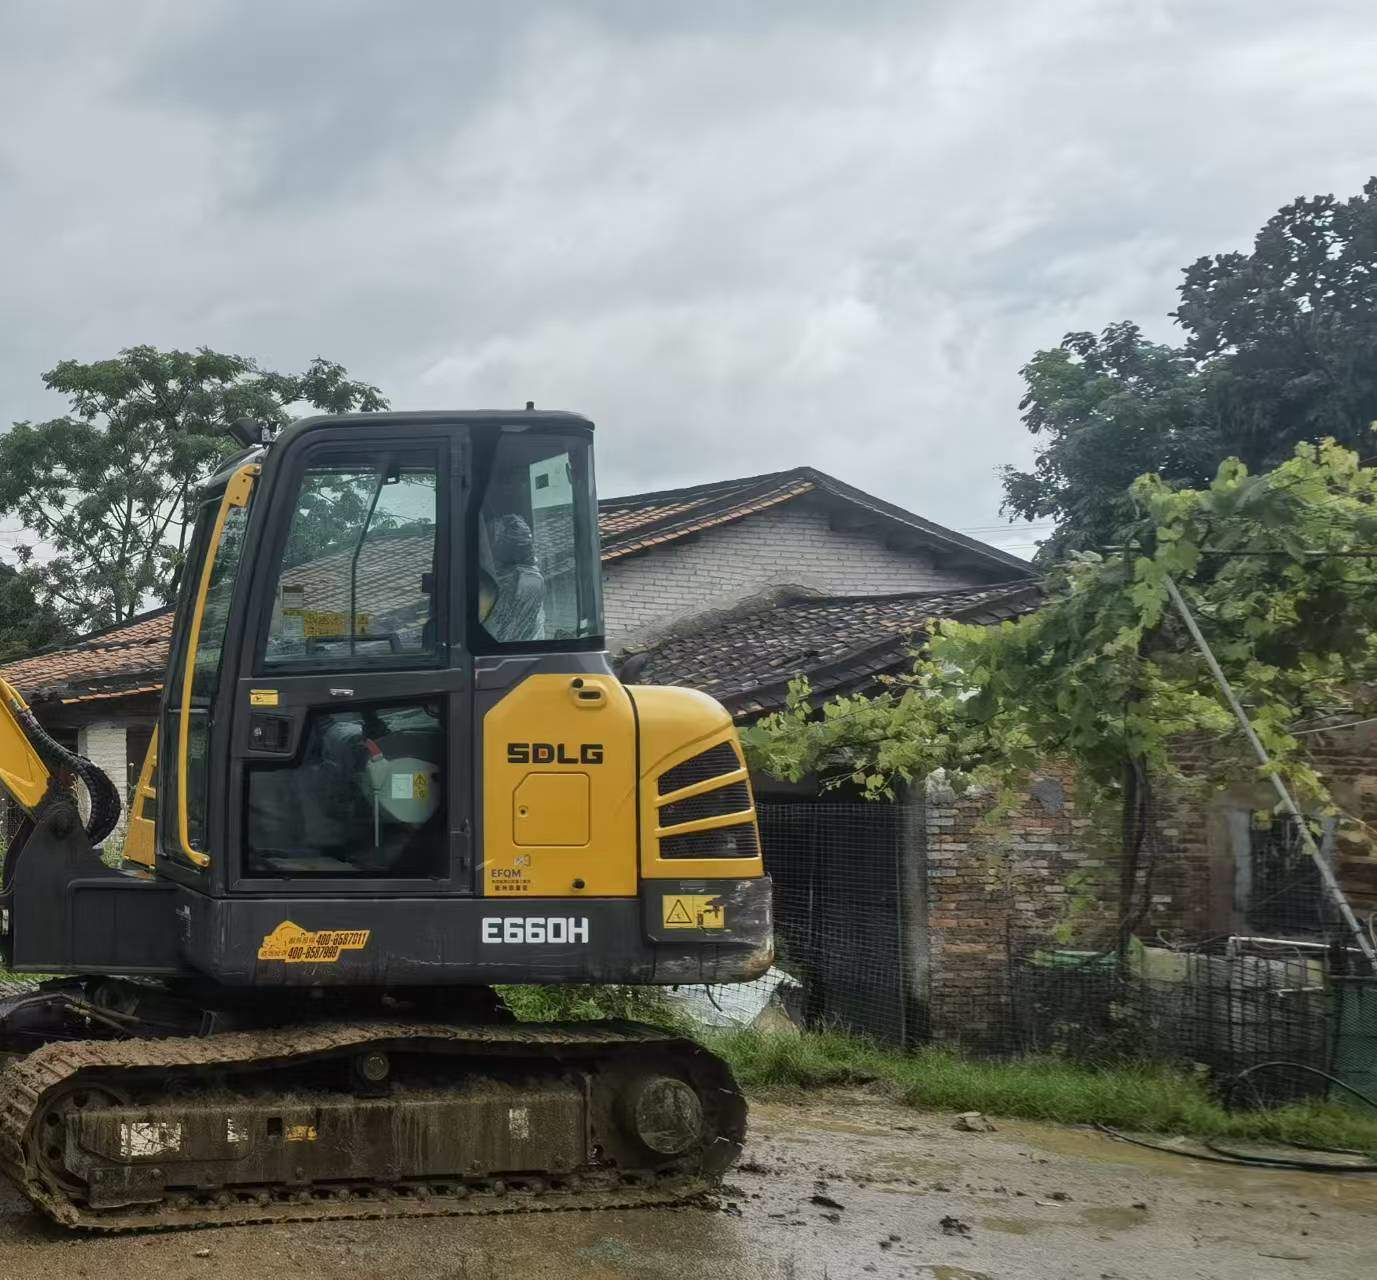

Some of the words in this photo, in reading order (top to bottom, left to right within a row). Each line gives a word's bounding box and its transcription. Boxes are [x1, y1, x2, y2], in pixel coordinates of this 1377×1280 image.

[507, 743, 603, 764] SDLG
[491, 869, 521, 879] EFQM
[482, 917, 589, 943] E660H
